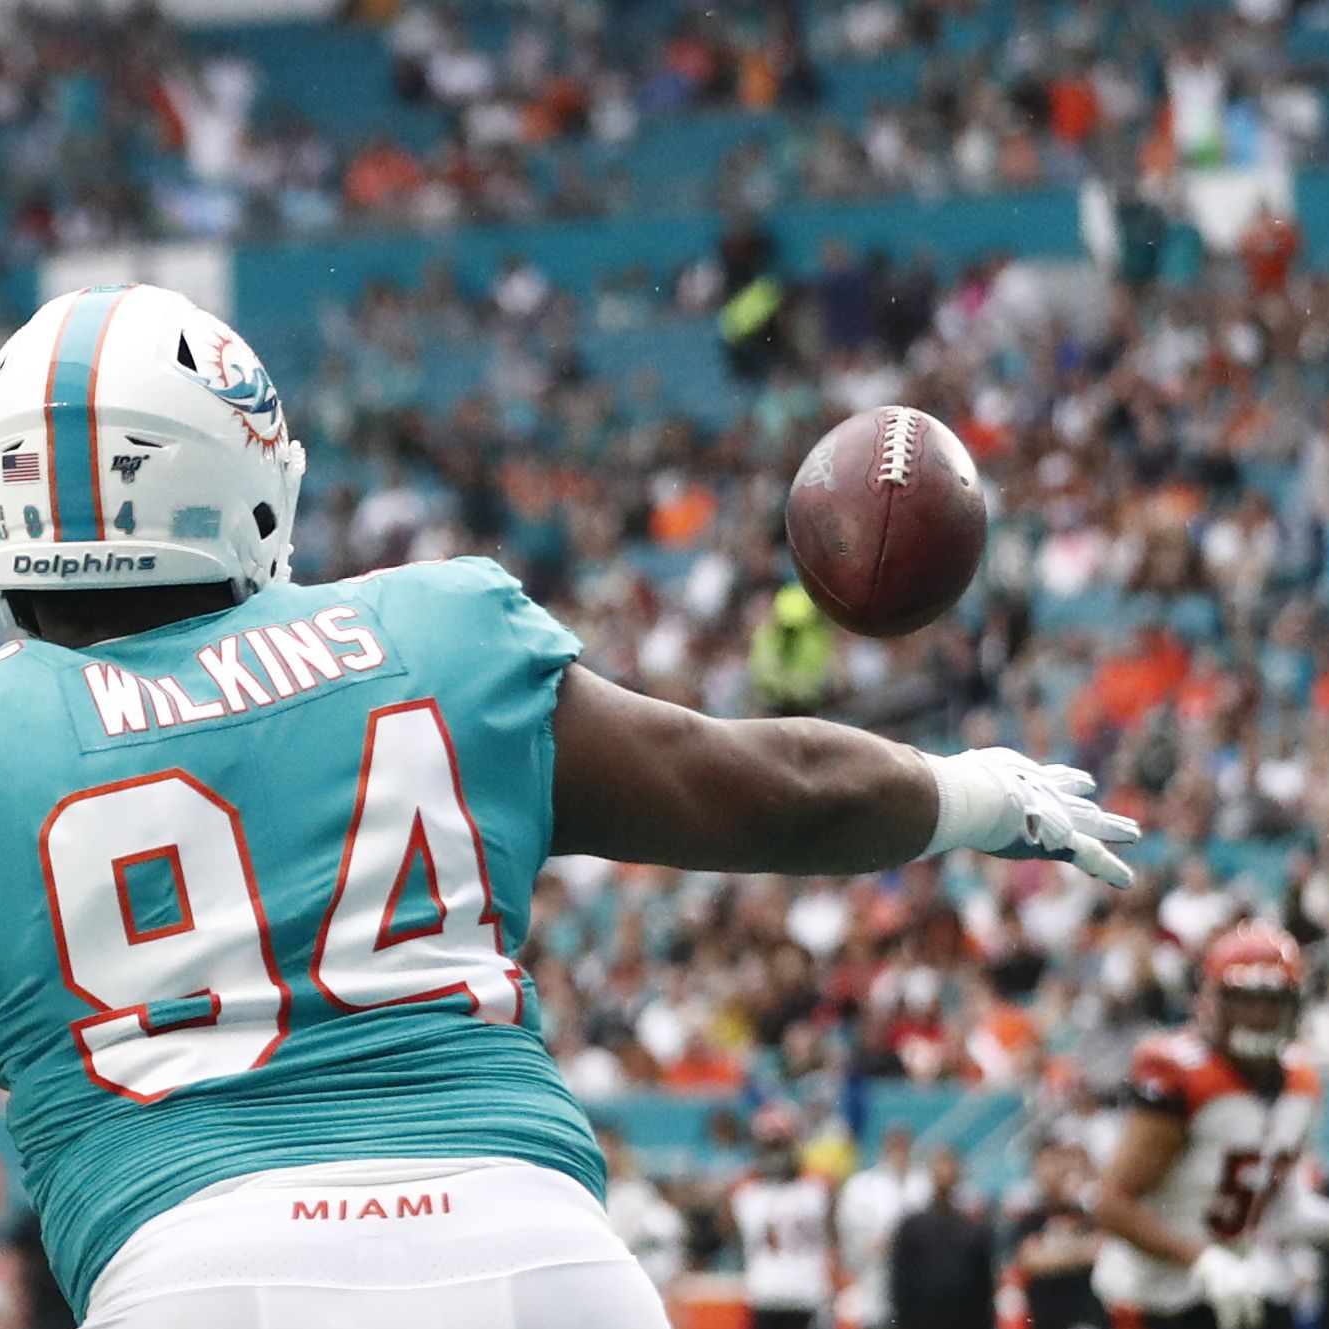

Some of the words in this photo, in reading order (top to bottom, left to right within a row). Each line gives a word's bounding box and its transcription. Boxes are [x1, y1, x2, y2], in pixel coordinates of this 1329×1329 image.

[13, 553, 156, 577] Dolphins
[81, 605, 386, 736] WILKINS
[39, 697, 523, 1105] 94
[291, 1193, 451, 1220] MIAMI
